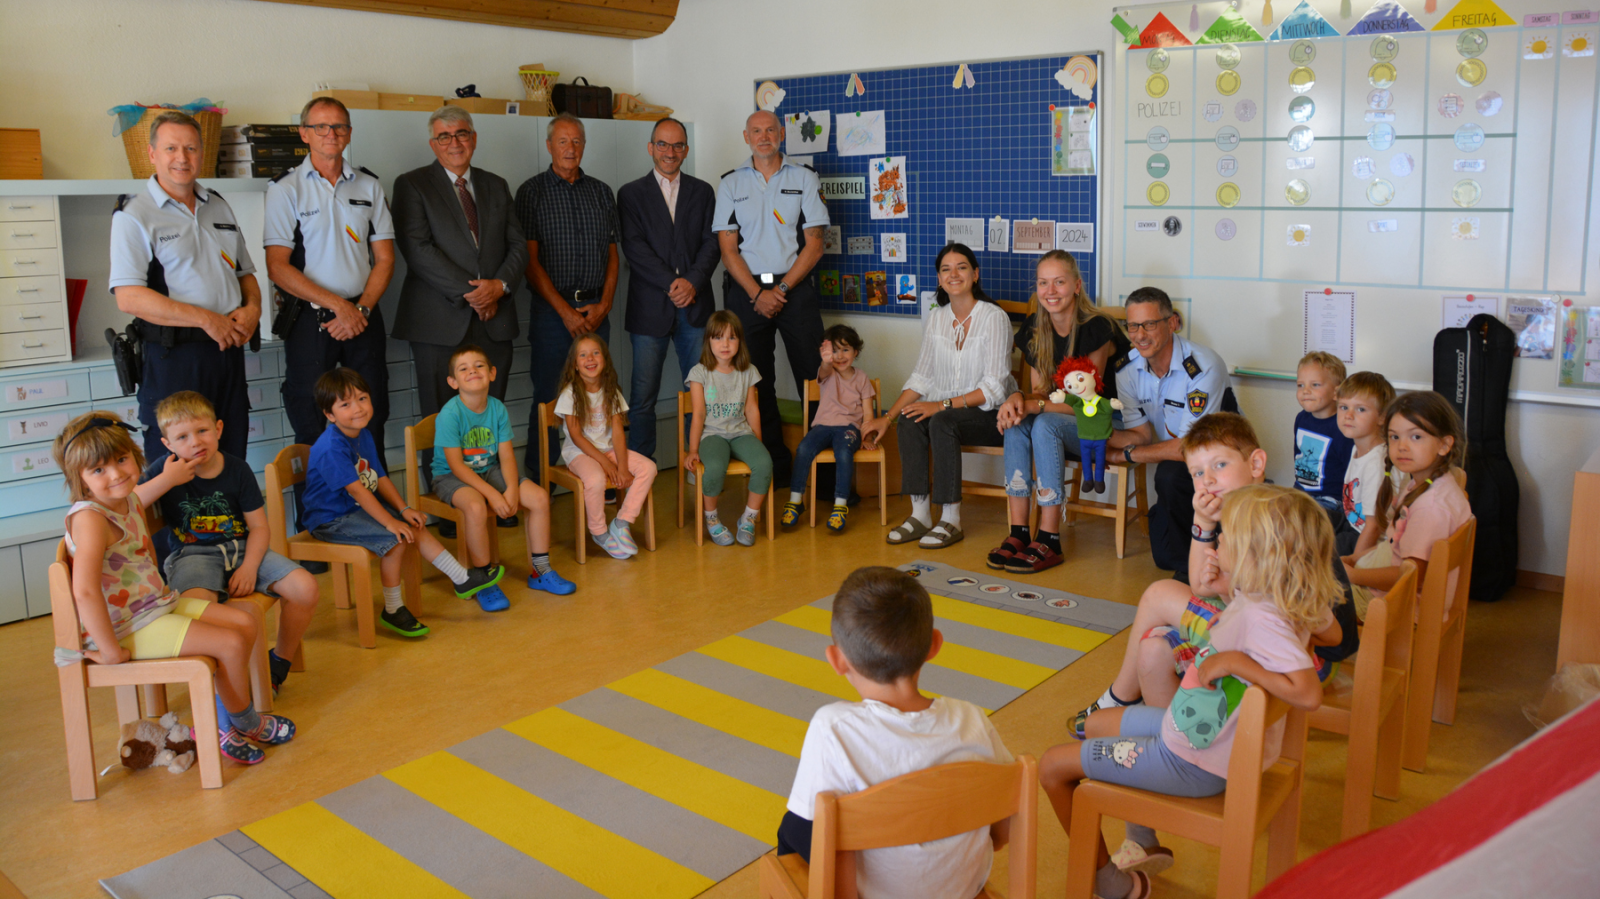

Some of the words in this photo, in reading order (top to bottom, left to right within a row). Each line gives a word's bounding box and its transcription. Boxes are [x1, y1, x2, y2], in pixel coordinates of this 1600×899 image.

[1362, 18, 1410, 33] DONNERSTAG
[1452, 12, 1497, 27] FREITAG
[1210, 27, 1251, 41] DIENSTAG
[1281, 21, 1326, 38] MITTWOCH
[1137, 101, 1182, 118] POLIZEI
[820, 182, 865, 195] FREISPIEL
[300, 208, 320, 218] Polizei
[949, 224, 973, 236] MONTAG
[1016, 226, 1051, 239] SEPTEMBER
[1061, 229, 1088, 243] 2024
[159, 233, 181, 243] Polizei
[1513, 306, 1545, 314] TAGESKIND
[705, 402, 745, 419] POWER
[33, 421, 48, 429] LIVIO
[37, 457, 49, 465] LEO
